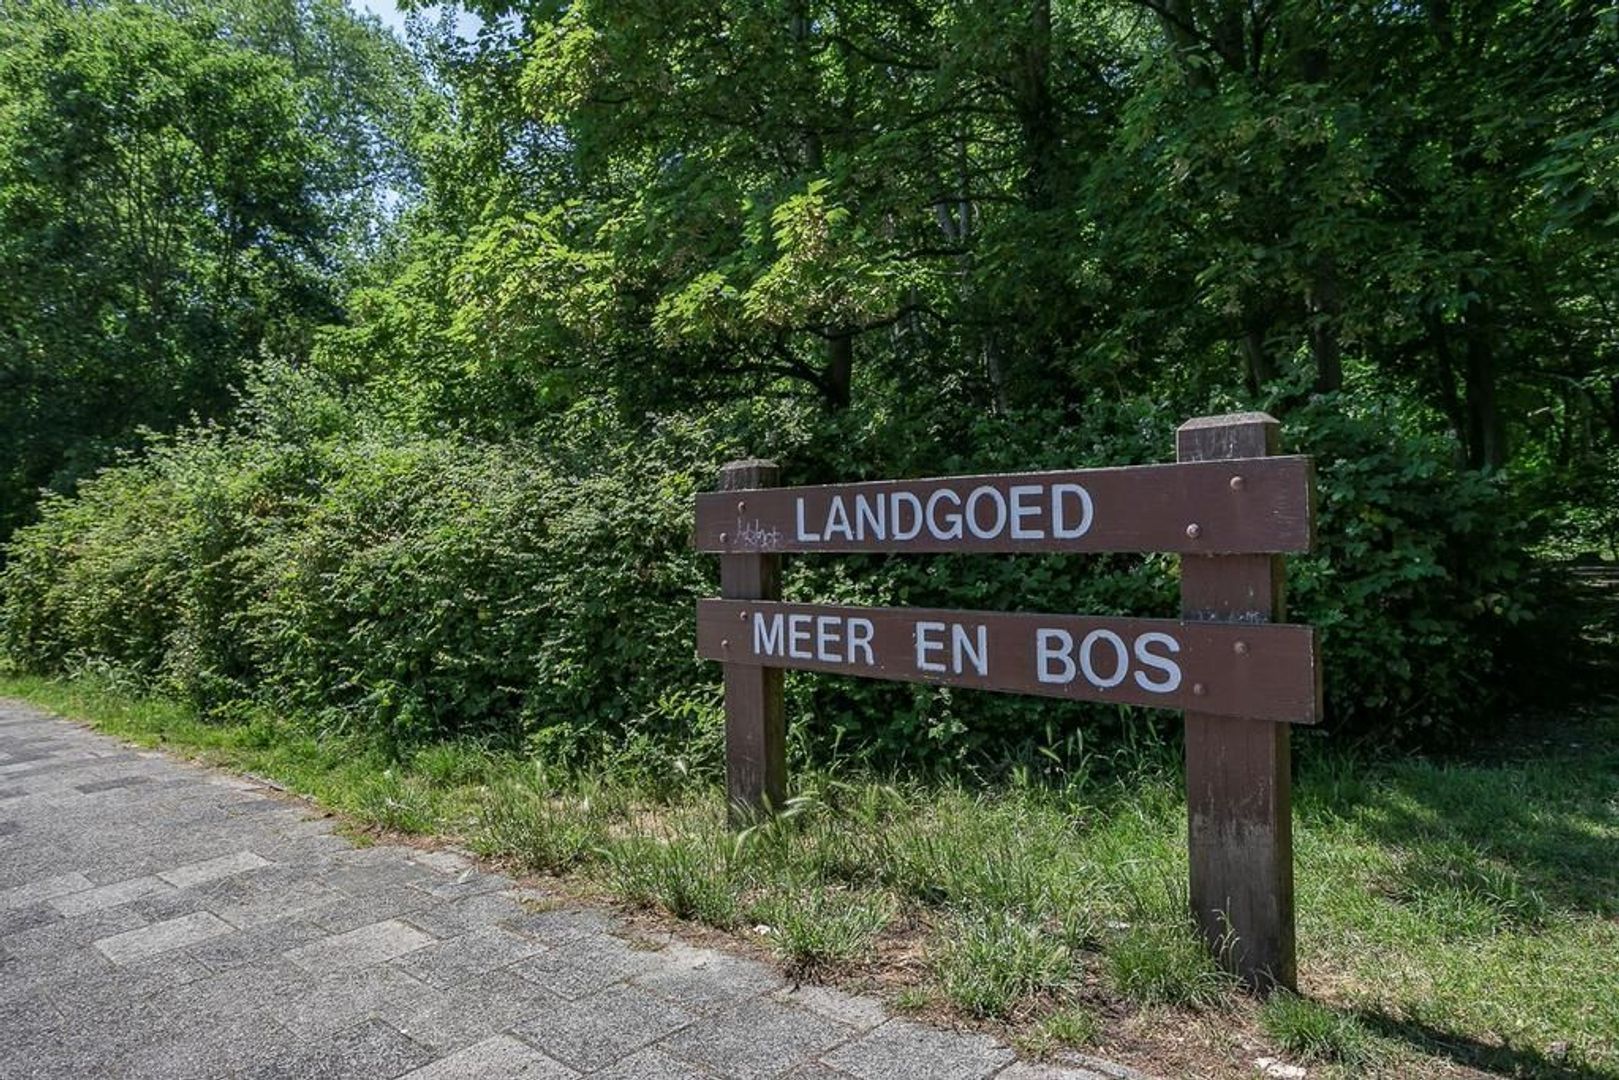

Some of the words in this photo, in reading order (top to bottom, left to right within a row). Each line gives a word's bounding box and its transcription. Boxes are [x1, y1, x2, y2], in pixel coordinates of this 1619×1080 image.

[796, 483, 1094, 542] LANDGOED
[753, 612, 875, 666] MEER
[915, 621, 988, 676] EN
[1036, 628, 1182, 693] BOS
